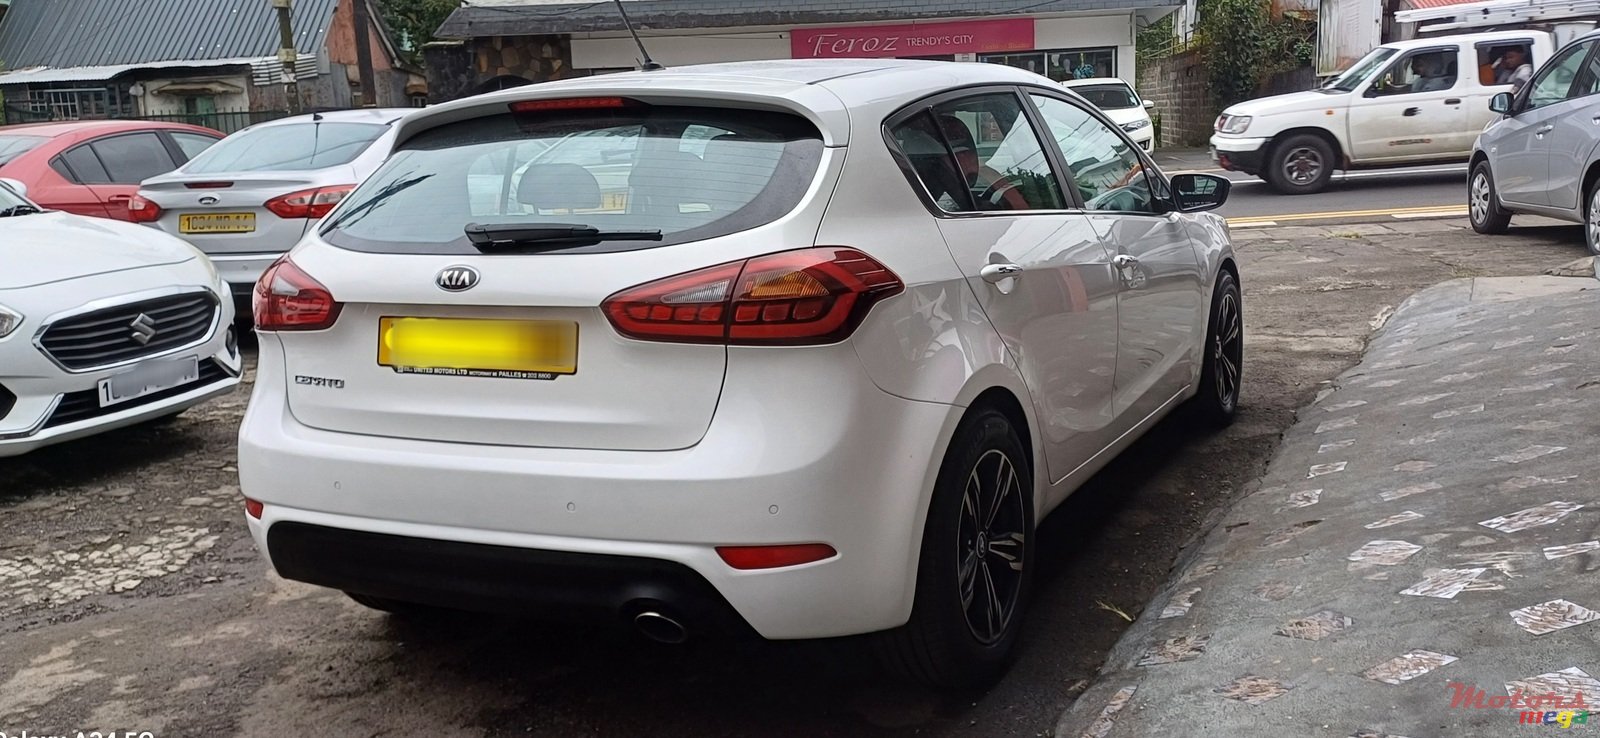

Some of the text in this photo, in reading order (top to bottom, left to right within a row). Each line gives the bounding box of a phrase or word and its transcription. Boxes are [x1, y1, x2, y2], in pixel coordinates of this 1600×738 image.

[808, 34, 974, 56] Feroz TRENDY'S CITY
[440, 270, 470, 286] KIA
